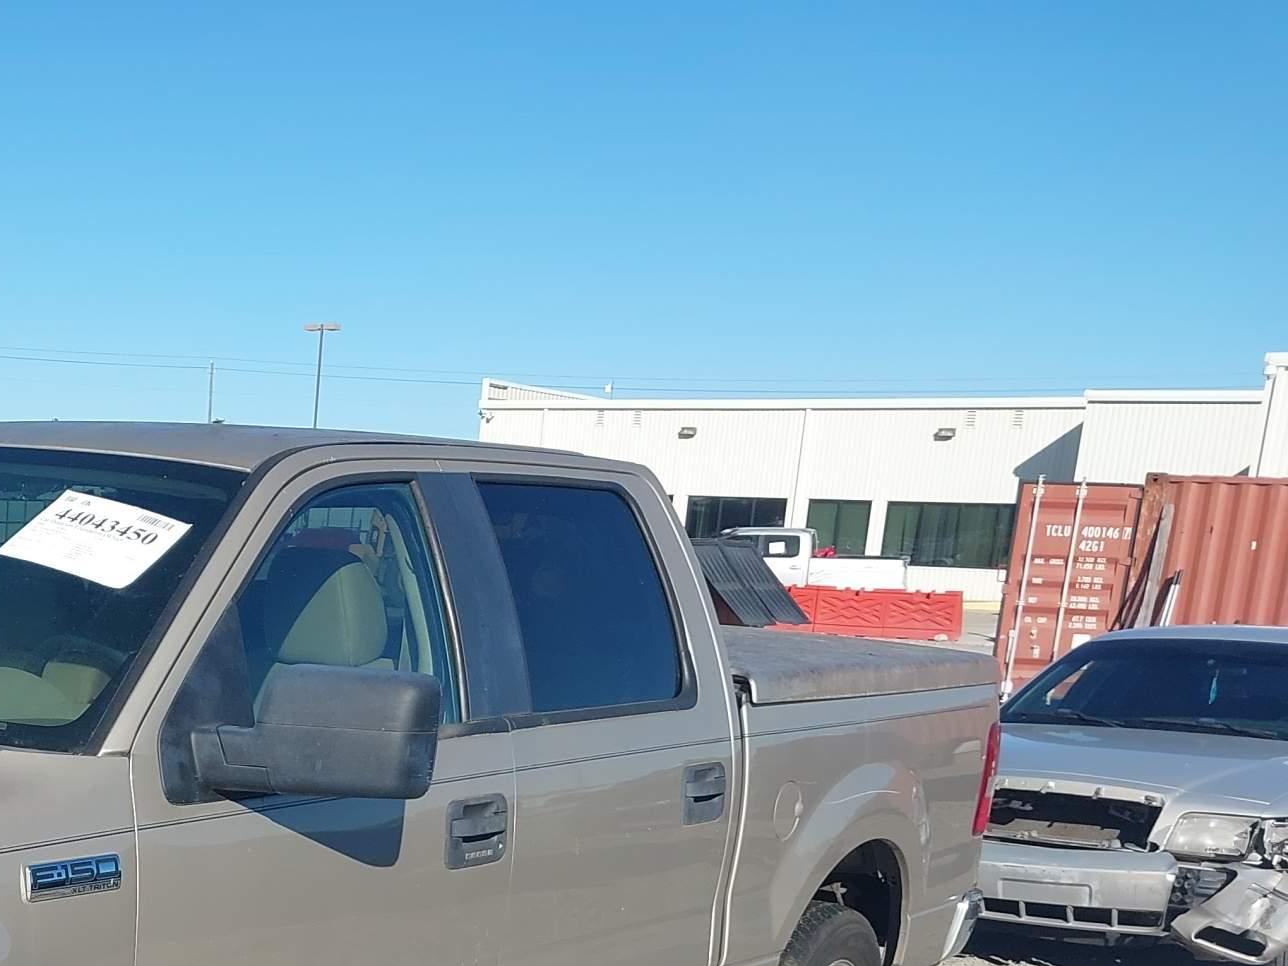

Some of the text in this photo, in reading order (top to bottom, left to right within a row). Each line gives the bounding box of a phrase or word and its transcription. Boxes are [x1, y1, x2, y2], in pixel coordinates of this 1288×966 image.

[55, 508, 159, 545] 44043450
[1045, 524, 1072, 537] TCLU
[1081, 526, 1120, 539] 400146
[1078, 540, 1105, 552] 42G1
